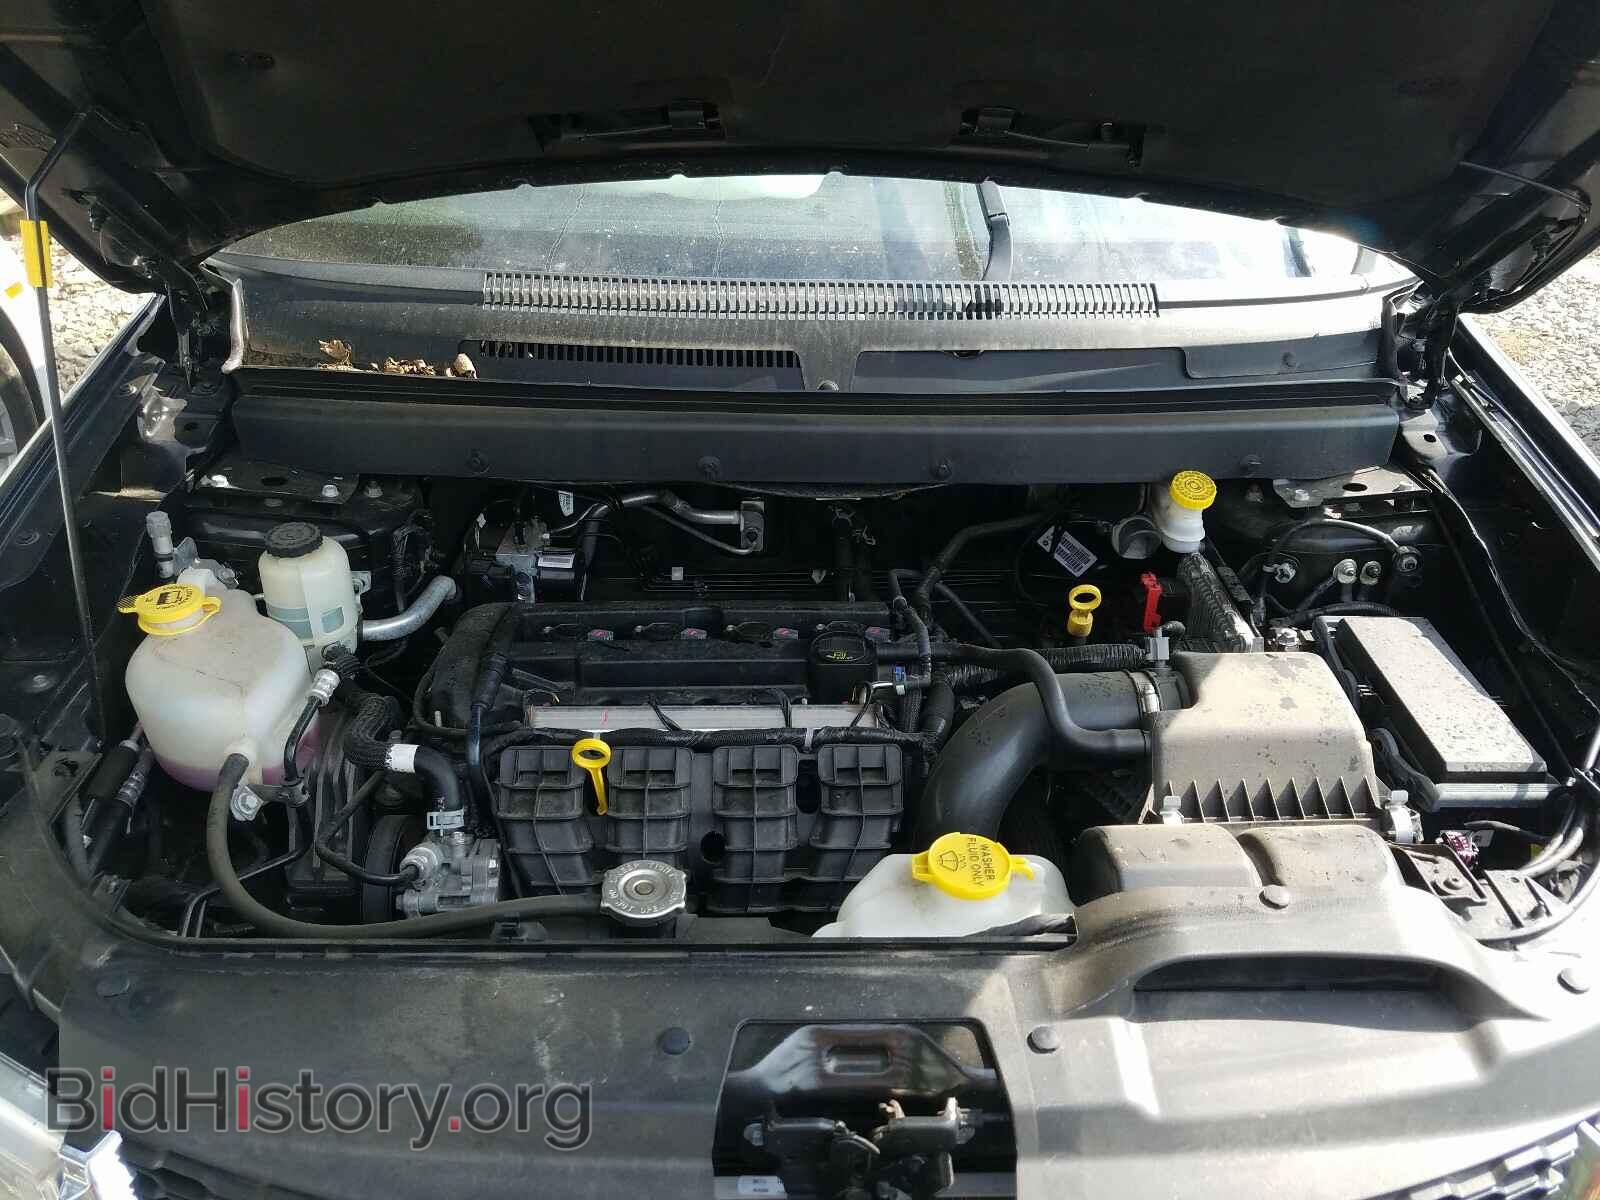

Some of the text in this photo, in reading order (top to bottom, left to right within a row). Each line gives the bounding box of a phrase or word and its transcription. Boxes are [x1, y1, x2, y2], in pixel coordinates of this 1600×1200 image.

[967, 836, 984, 887] FLUID ONLY
[980, 843, 996, 881] WASHER
